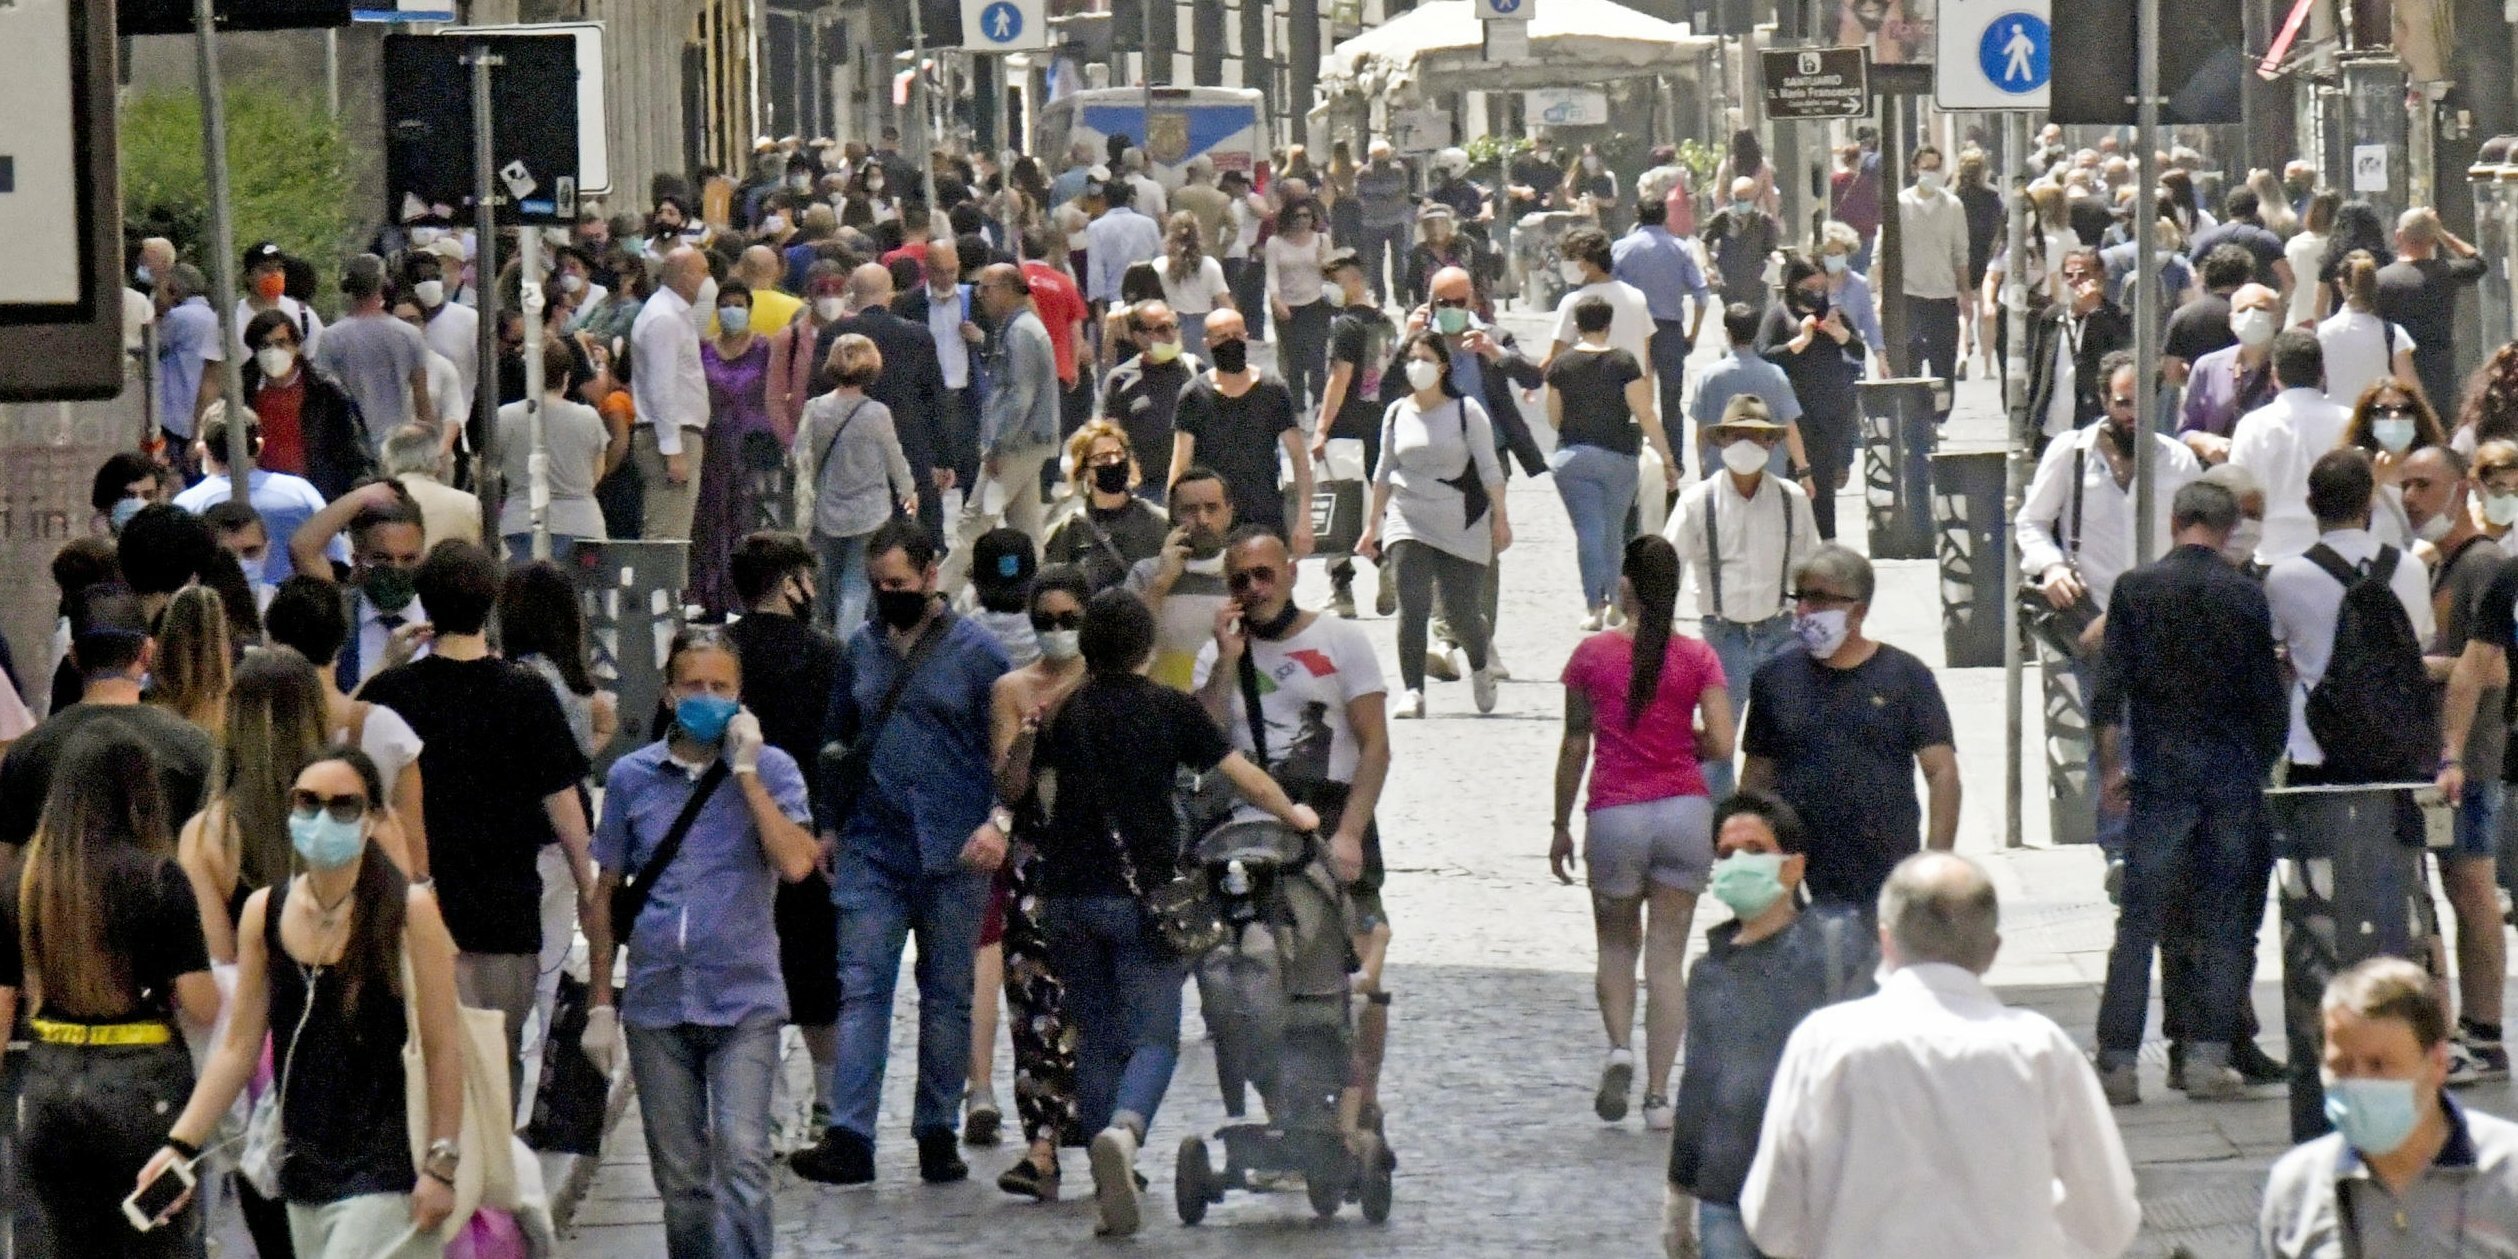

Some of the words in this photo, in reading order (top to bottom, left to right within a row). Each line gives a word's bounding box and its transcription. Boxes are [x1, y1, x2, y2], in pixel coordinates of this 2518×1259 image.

[1783, 75, 1842, 87] SANTUARIO
[1768, 88, 1779, 99] S.
[1780, 87, 1806, 99] Maria
[1807, 86, 1861, 97] Francesca
